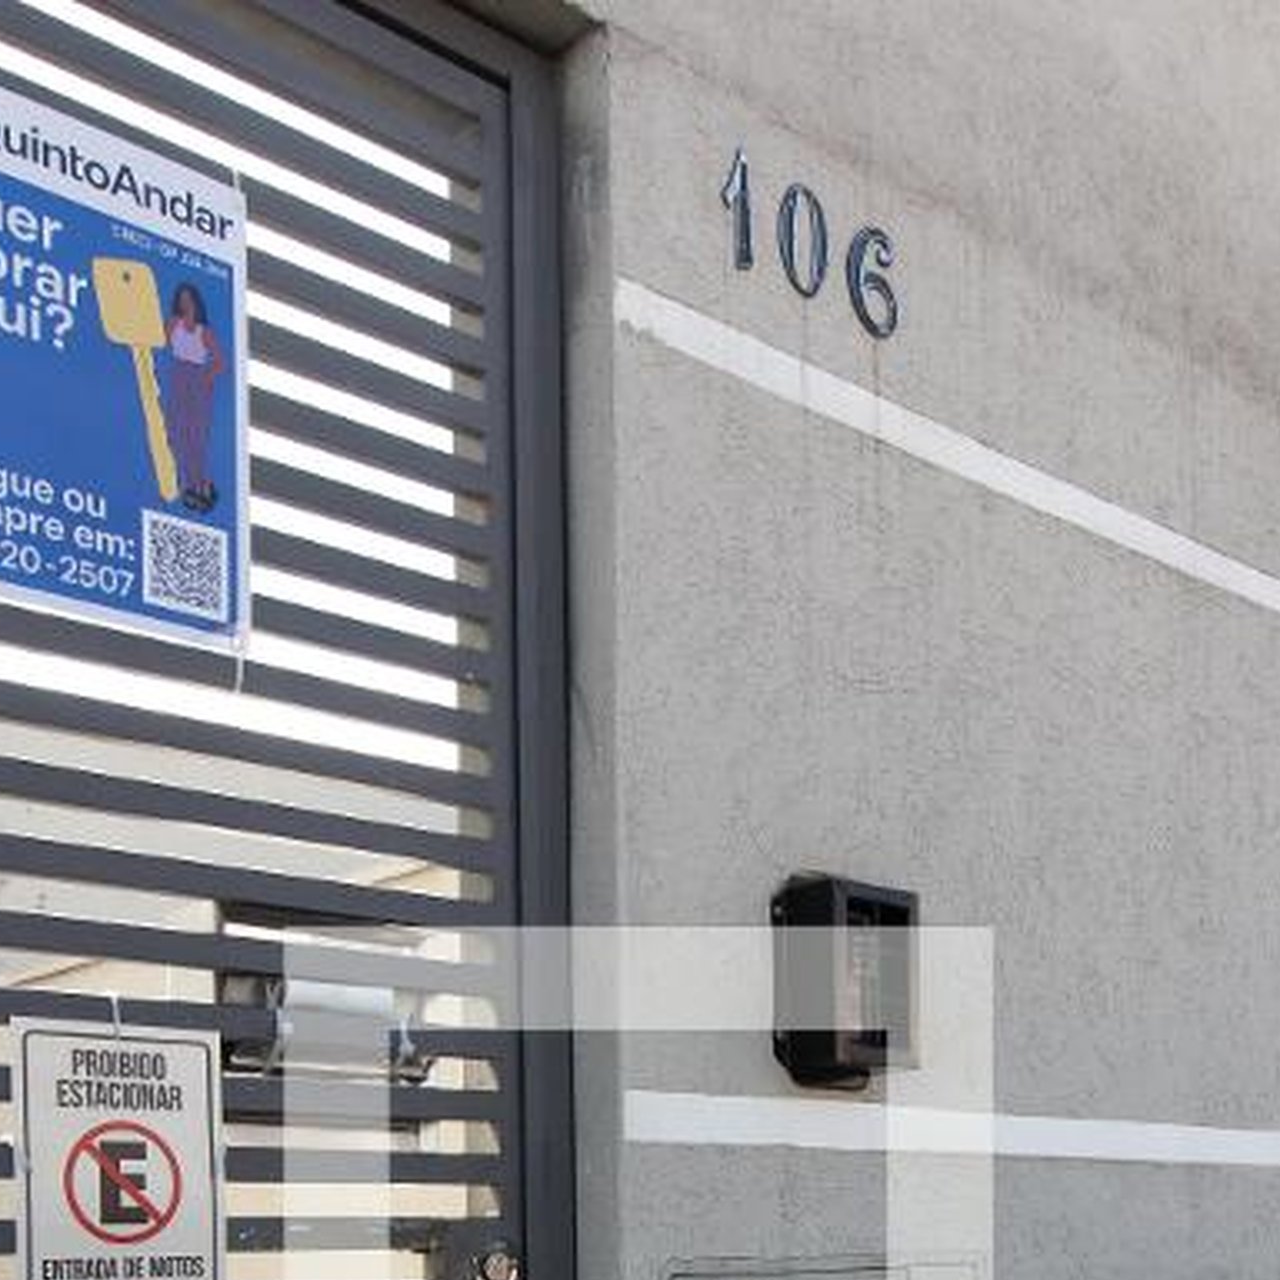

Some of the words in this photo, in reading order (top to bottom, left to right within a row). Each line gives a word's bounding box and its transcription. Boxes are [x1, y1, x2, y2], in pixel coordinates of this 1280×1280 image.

[720, 148, 898, 338] 106
[62, 488, 107, 520] ou
[73, 524, 136, 562] em:
[71, 1048, 167, 1081] PROIBIDO
[56, 1079, 183, 1111] ESTACIONAR
[41, 1258, 118, 1280] ENTRADA
[123, 1255, 145, 1279] DE
[148, 1255, 205, 1279] MOTOS
